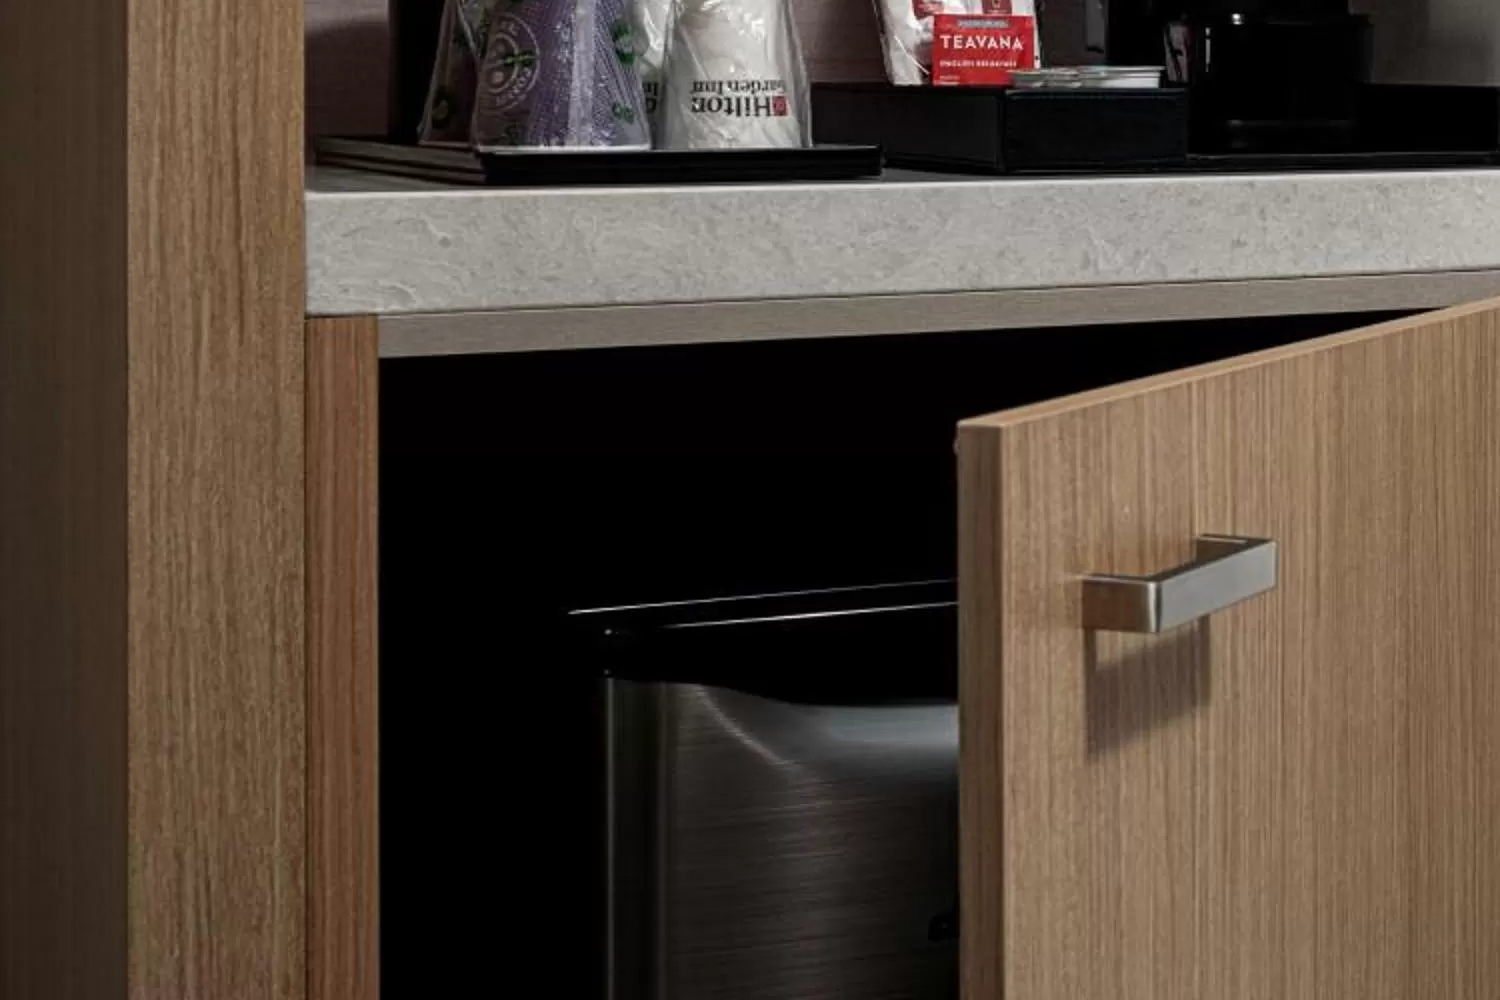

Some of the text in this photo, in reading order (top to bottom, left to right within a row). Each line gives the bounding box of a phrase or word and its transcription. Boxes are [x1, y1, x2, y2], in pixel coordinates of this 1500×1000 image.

[939, 34, 1023, 51] TEAVANA
[690, 80, 723, 95] Inn
[691, 96, 771, 117] Hilton
